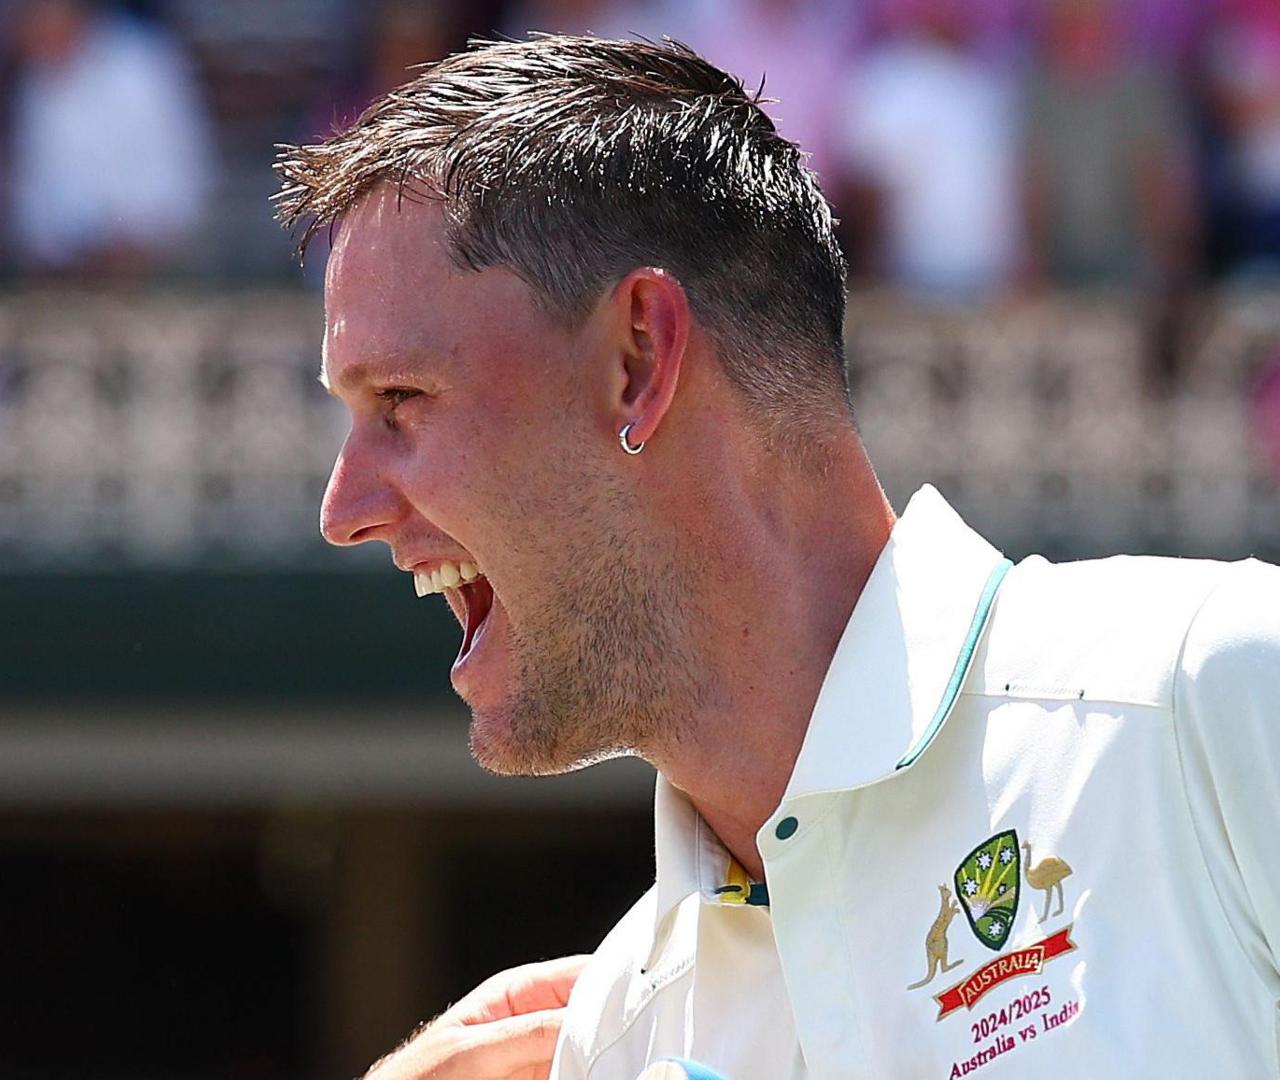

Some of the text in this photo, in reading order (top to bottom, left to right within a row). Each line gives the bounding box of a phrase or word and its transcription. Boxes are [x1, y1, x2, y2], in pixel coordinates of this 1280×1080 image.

[965, 952, 1040, 1003] AUSTRALIA
[971, 985, 1051, 1044] 2024/2025
[1019, 1025, 1037, 1042] vs
